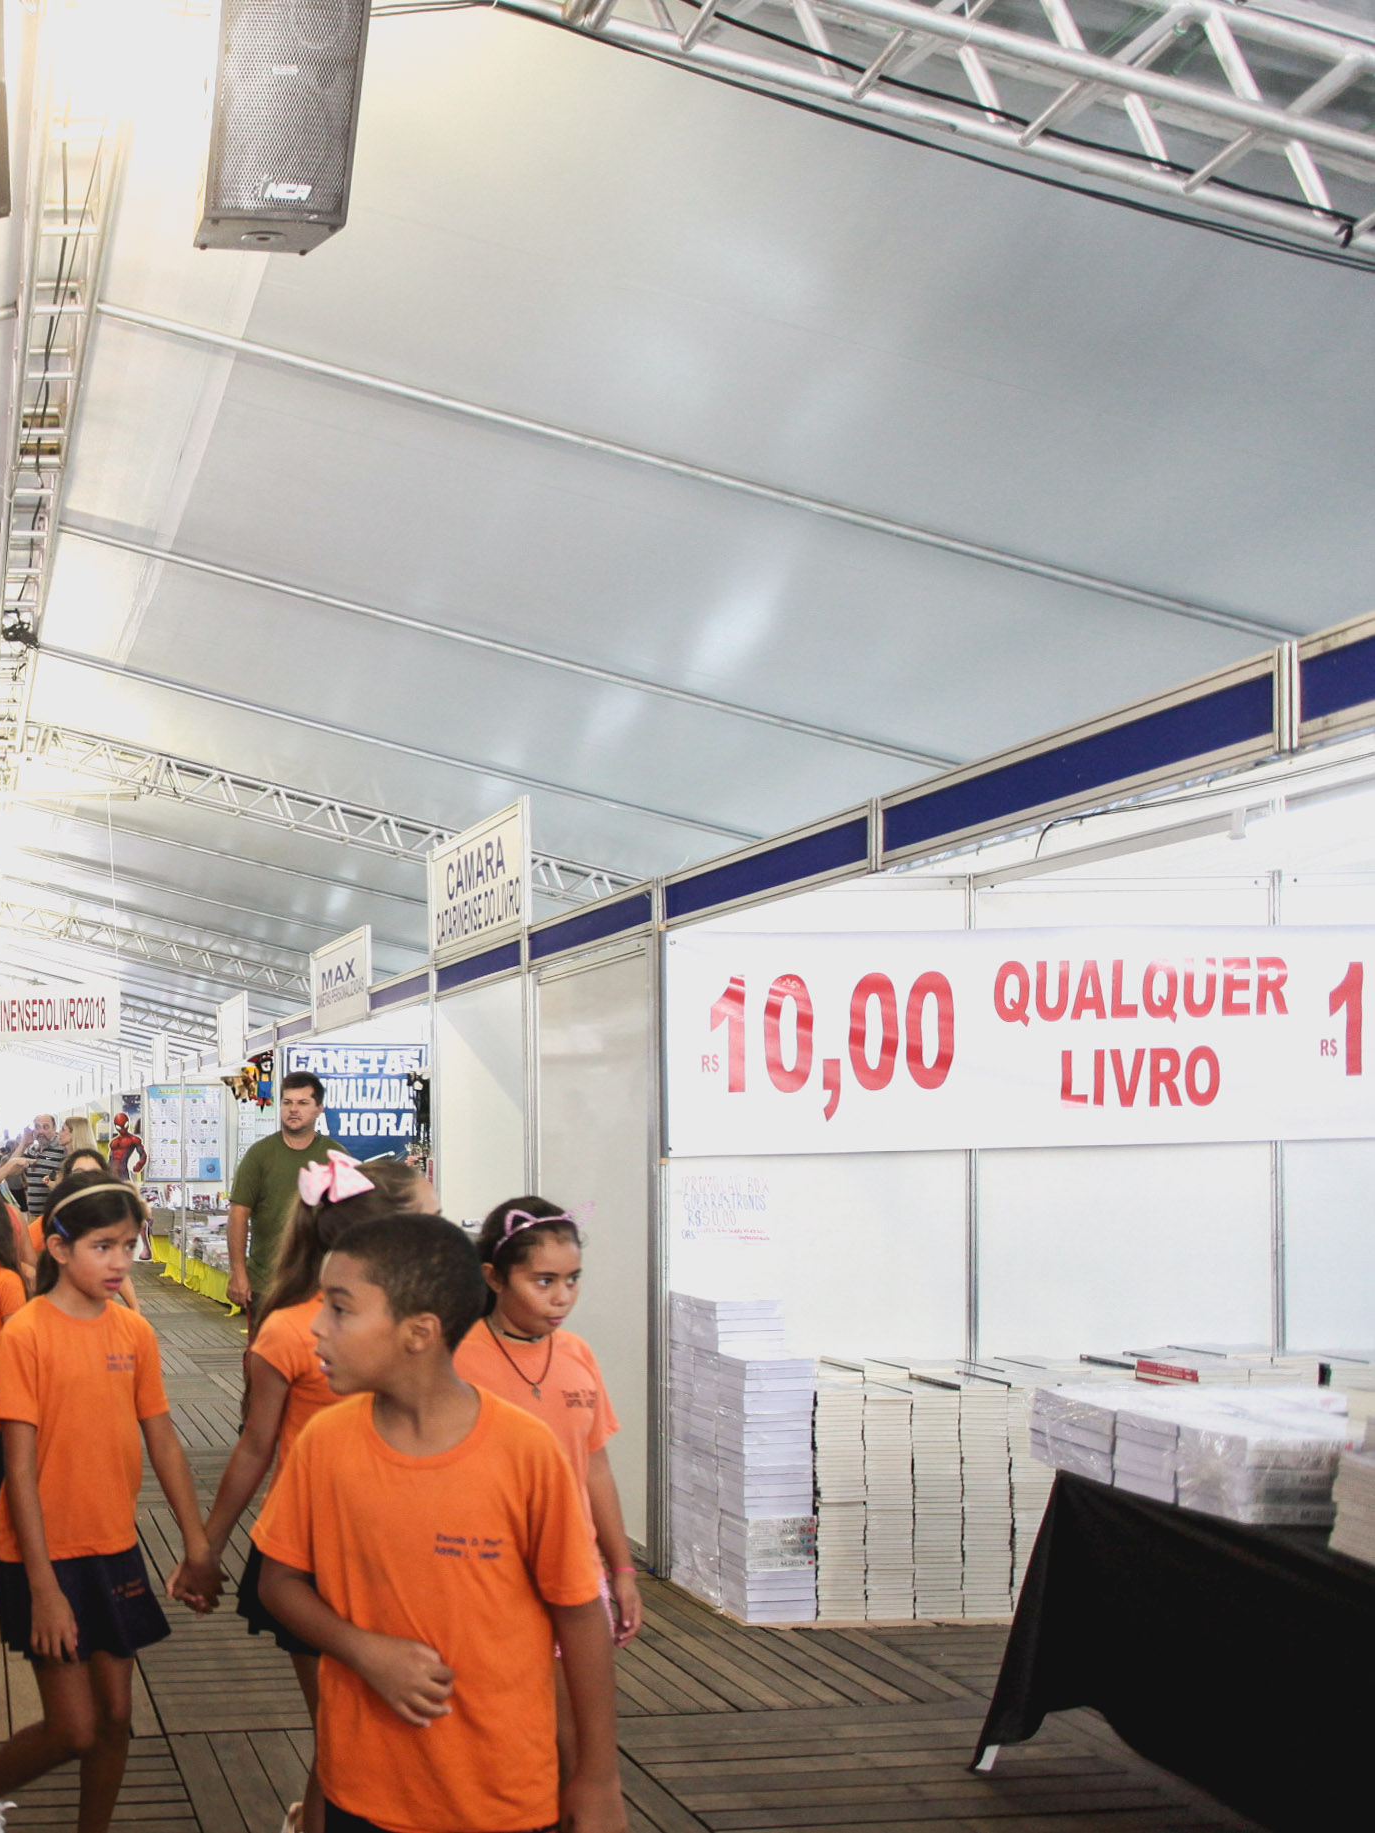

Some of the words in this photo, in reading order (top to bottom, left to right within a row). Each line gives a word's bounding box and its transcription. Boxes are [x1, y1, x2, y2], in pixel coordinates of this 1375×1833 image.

[437, 893, 483, 946] CATARINENSE
[484, 887, 496, 928] DO
[496, 876, 521, 922] LIVRO
[321, 957, 356, 991] MAX
[992, 955, 1289, 1027] QUALQUER
[289, 1049, 420, 1074] CANETAS
[700, 1054, 721, 1073] R$
[709, 971, 955, 1123] 10,00
[1319, 1038, 1339, 1058] R$
[1060, 1045, 1221, 1109] LIVRO
